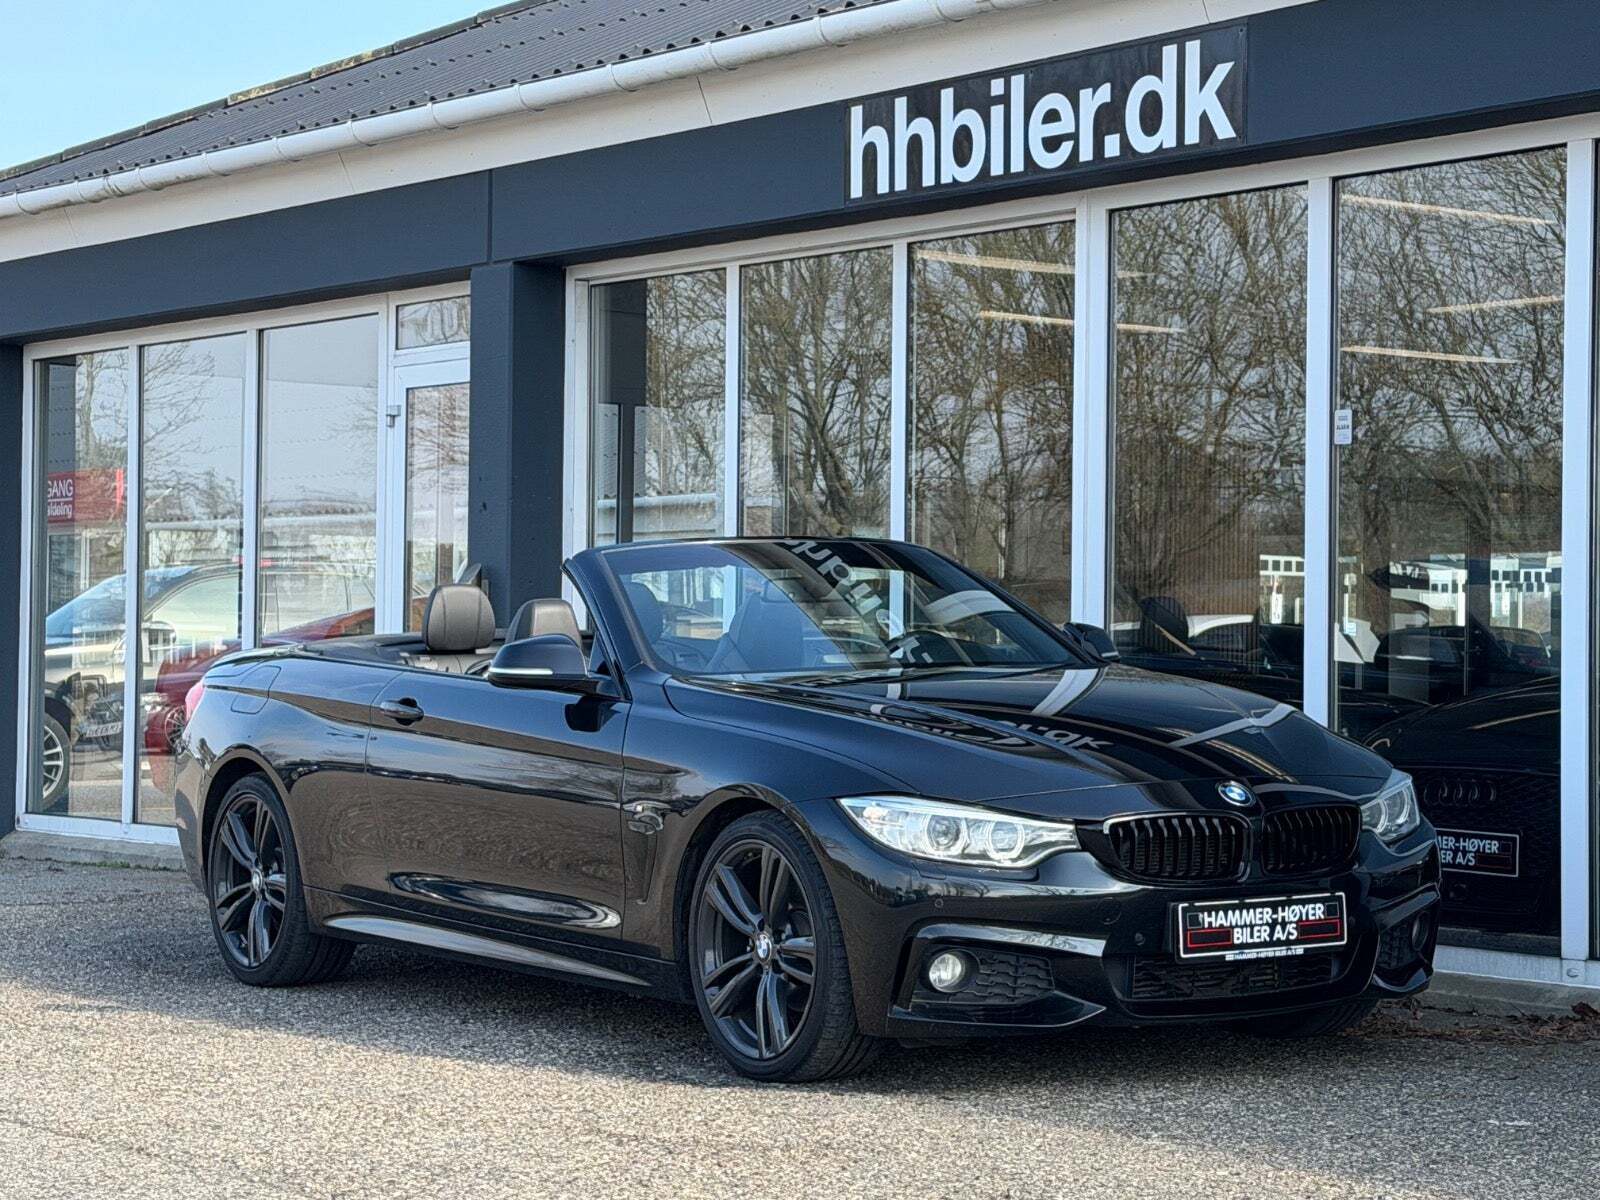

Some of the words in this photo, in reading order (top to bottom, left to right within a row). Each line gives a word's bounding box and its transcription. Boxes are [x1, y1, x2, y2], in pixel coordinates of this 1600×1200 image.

[850, 39, 1237, 199] hhbiler.dk
[1455, 851, 1476, 866] A/S
[1203, 903, 1325, 928] HAMMER-HØYER
[1233, 926, 1270, 944] BILER
[1272, 923, 1298, 941] A/S
